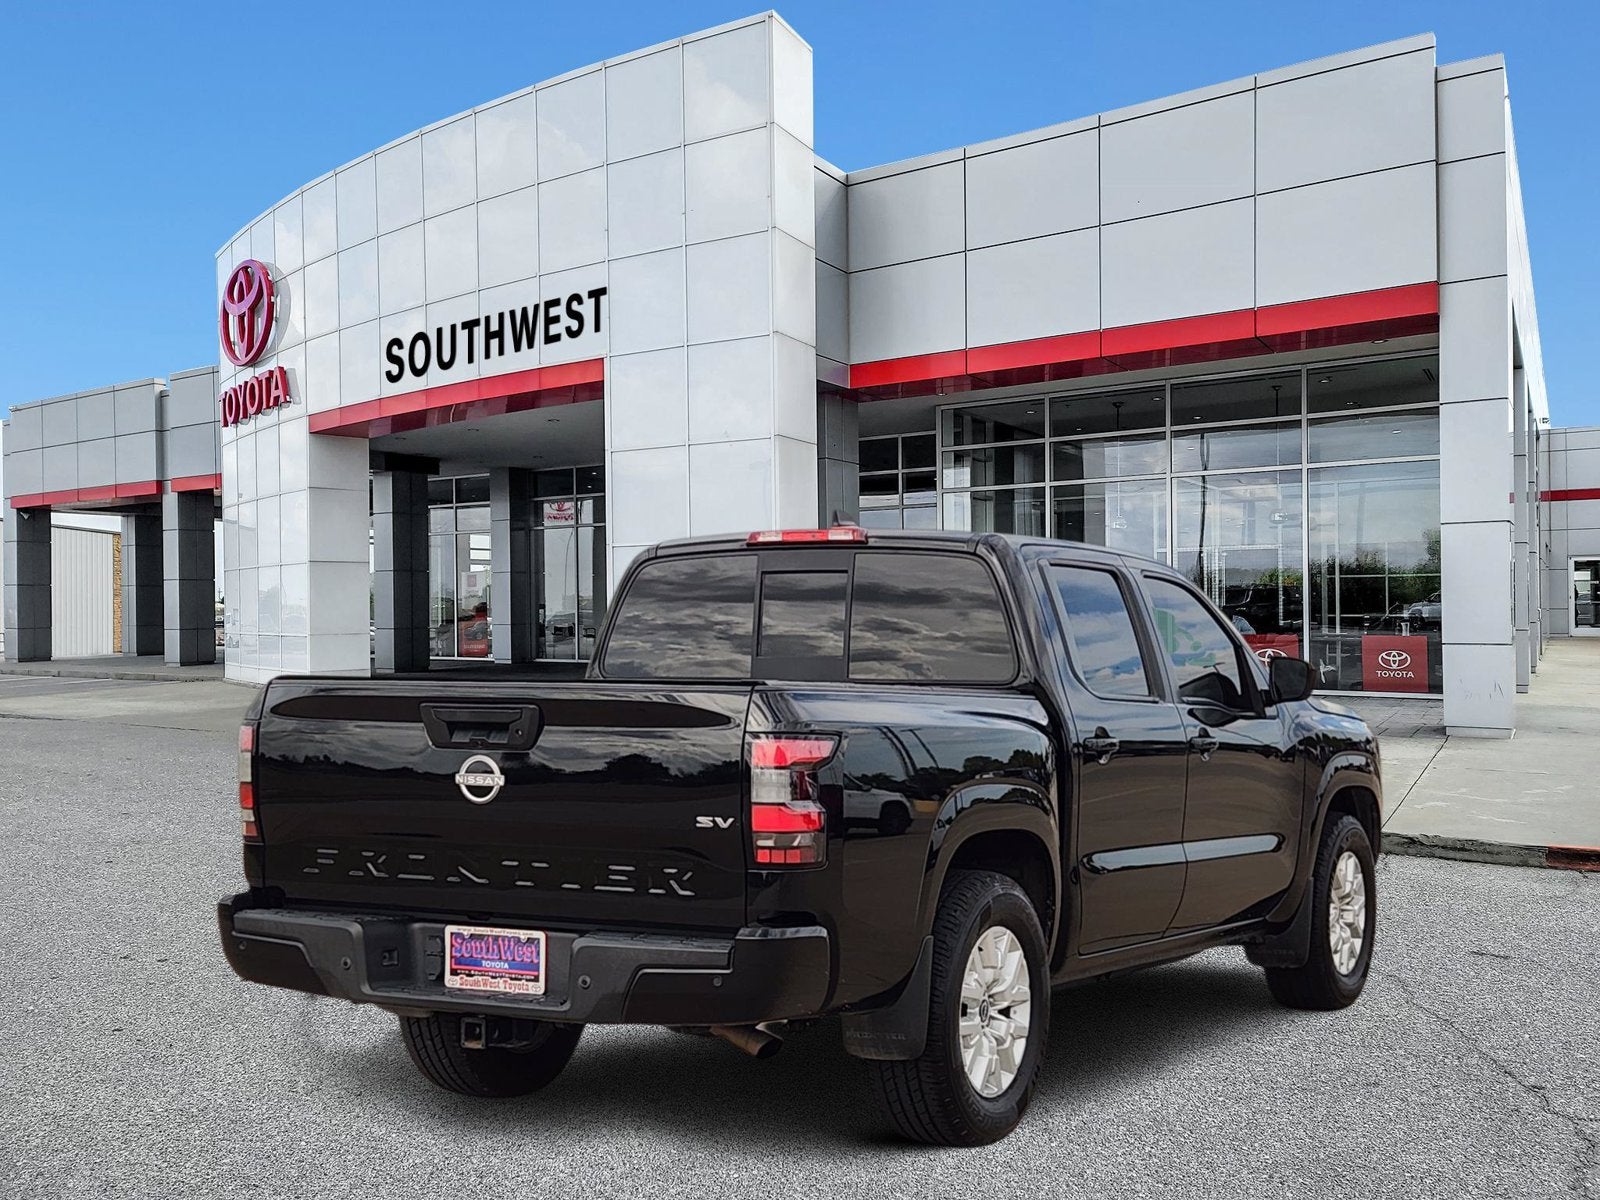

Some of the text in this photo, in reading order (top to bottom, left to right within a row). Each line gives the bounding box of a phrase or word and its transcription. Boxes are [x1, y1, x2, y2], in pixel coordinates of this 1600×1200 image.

[385, 287, 607, 383] SOUTHWEST
[218, 366, 289, 427] TOYOTA
[1376, 670, 1414, 678] TOYOTA
[455, 774, 504, 786] NISSAN
[696, 816, 735, 828] SV
[482, 961, 509, 969] TOYOTA
[503, 980, 530, 993] Toyota
